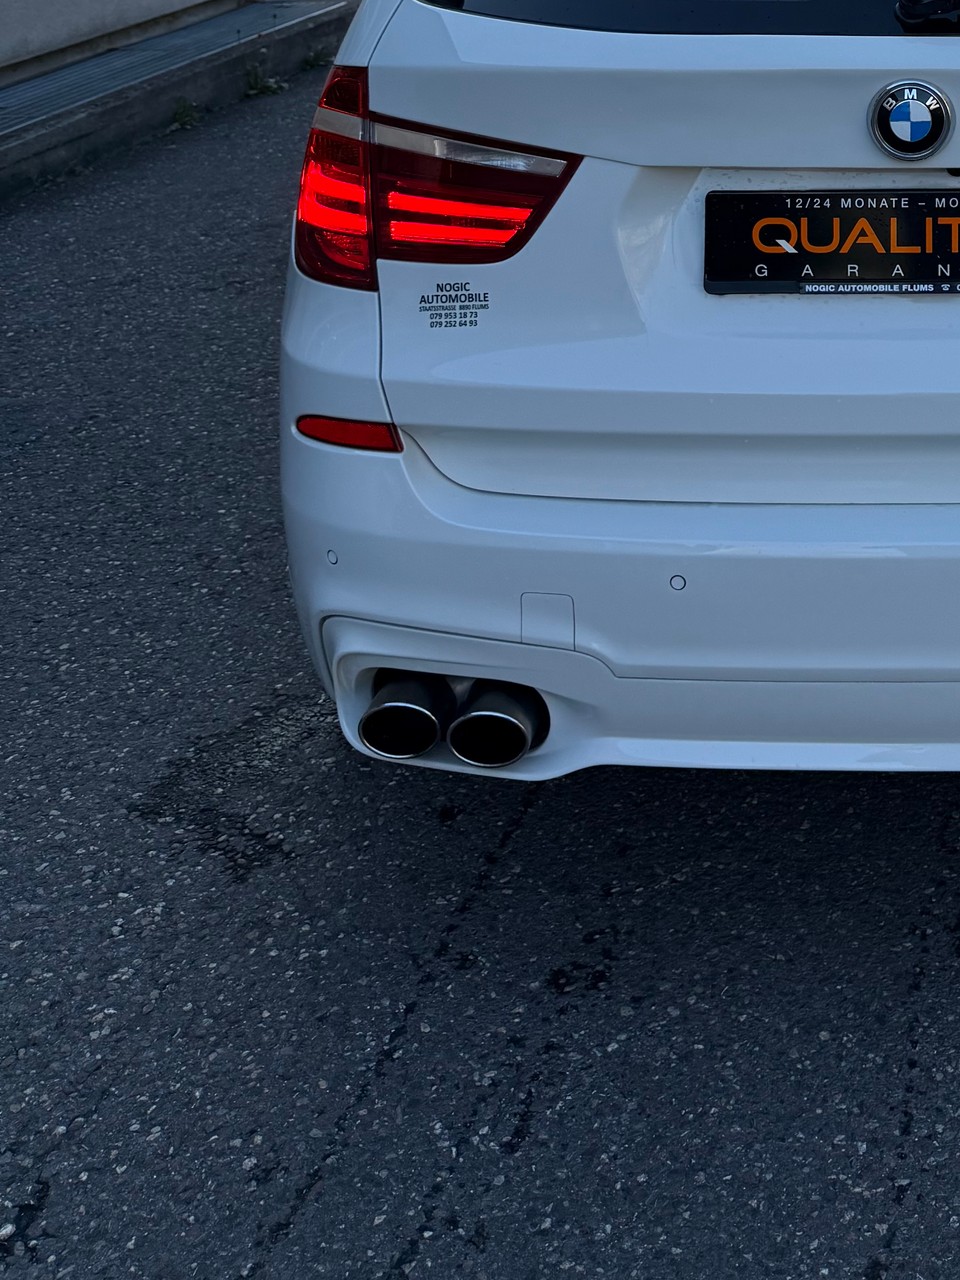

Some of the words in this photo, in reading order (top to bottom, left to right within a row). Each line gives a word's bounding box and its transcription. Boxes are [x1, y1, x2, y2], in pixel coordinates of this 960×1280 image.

[882, 88, 940, 111] BMW
[786, 198, 831, 208] 12/24
[840, 198, 909, 208] MONATE
[436, 282, 470, 292] NOGIC
[805, 284, 836, 292] NOGIC
[837, 284, 900, 292] AUTOMOBILE
[902, 284, 934, 292] FLUMS
[419, 293, 489, 304] AUTOMOBILE
[430, 312, 442, 320] 079
